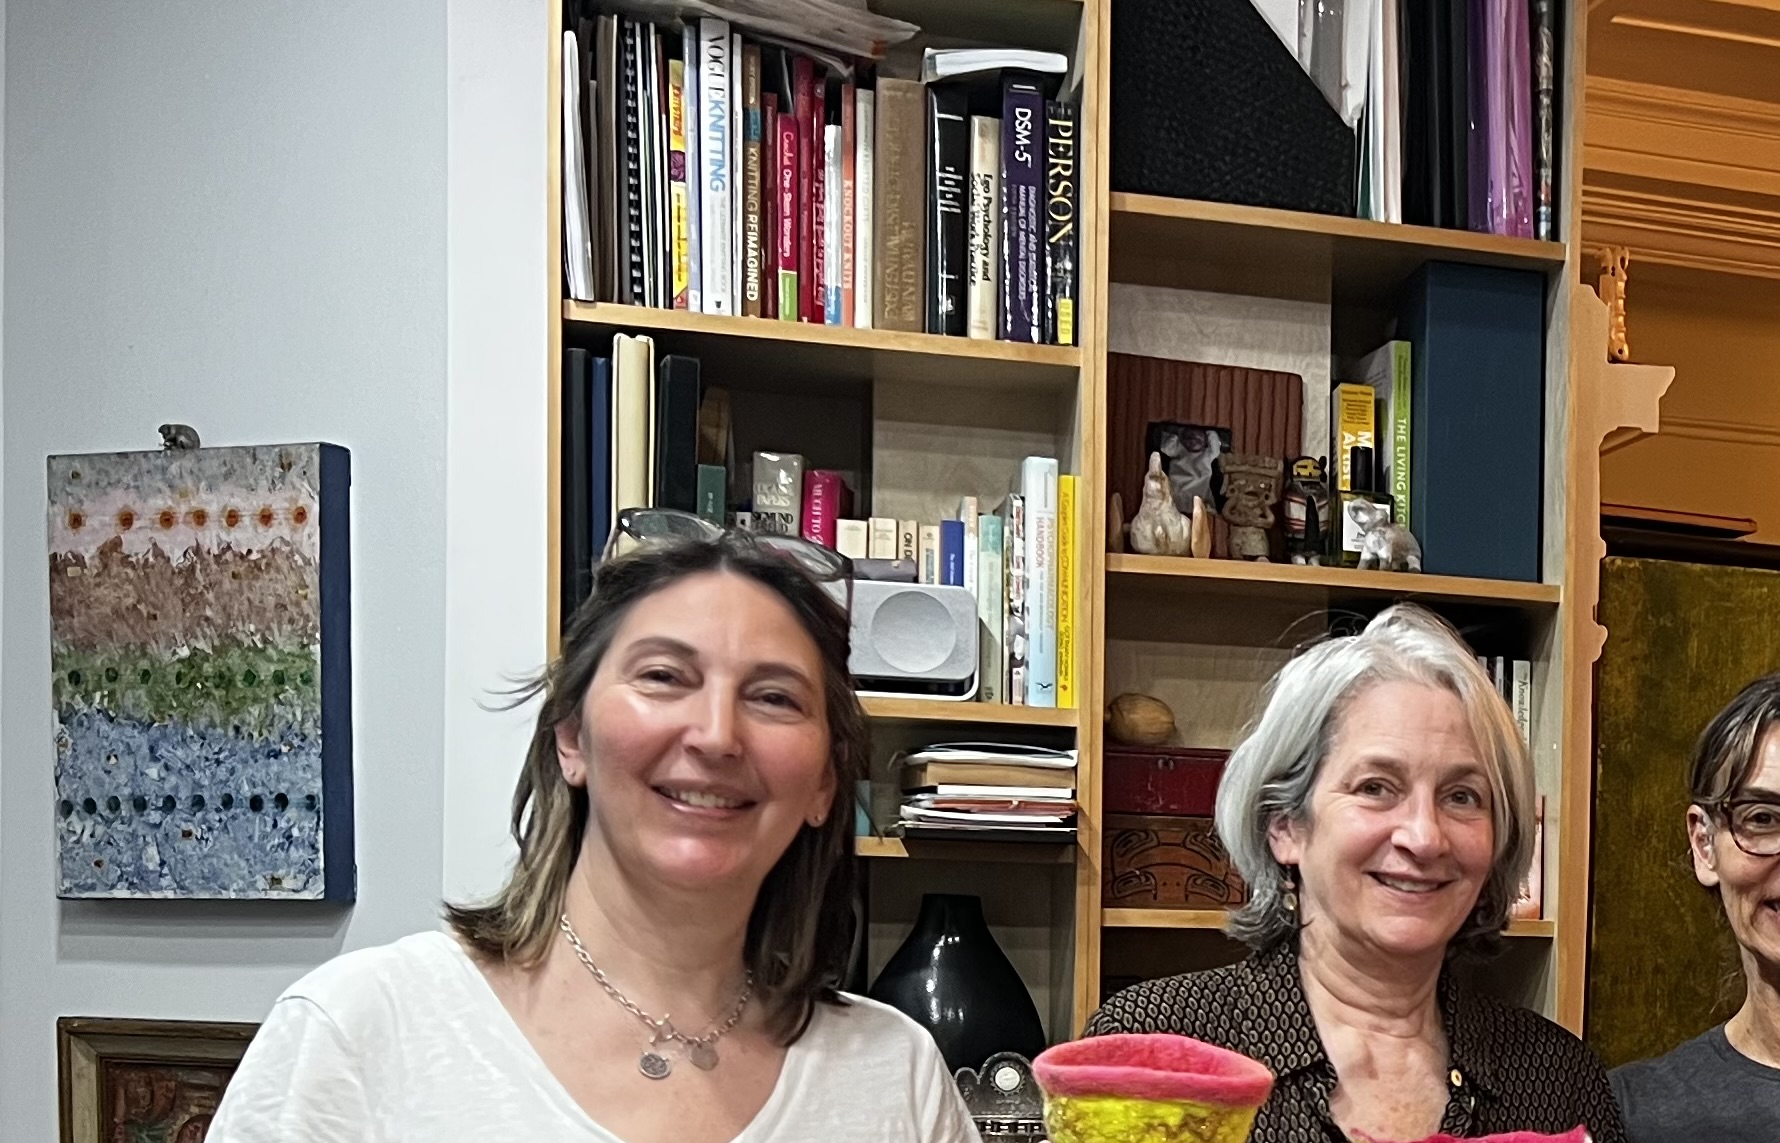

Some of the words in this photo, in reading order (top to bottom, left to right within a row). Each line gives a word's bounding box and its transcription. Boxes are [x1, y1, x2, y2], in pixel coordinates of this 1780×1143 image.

[708, 36, 726, 97] VOGUE
[709, 100, 726, 192] KNITTING
[747, 147, 759, 212] KNITTING
[981, 174, 993, 193] Ego
[1048, 118, 1074, 243] PERSON
[843, 179, 854, 249] KNOCKOUT
[980, 197, 993, 257] Psychology
[1018, 218, 1027, 229] OF
[746, 214, 759, 301] REIMAGINED
[843, 252, 854, 289] KNITS
[982, 258, 992, 282] and
[1060, 301, 1073, 336] USED
[1396, 418, 1407, 443] THE
[1396, 446, 1407, 491] LIVING
[1396, 495, 1406, 529] KITC
[903, 532, 913, 547] ON
[1036, 516, 1045, 568] HANDBOOK
